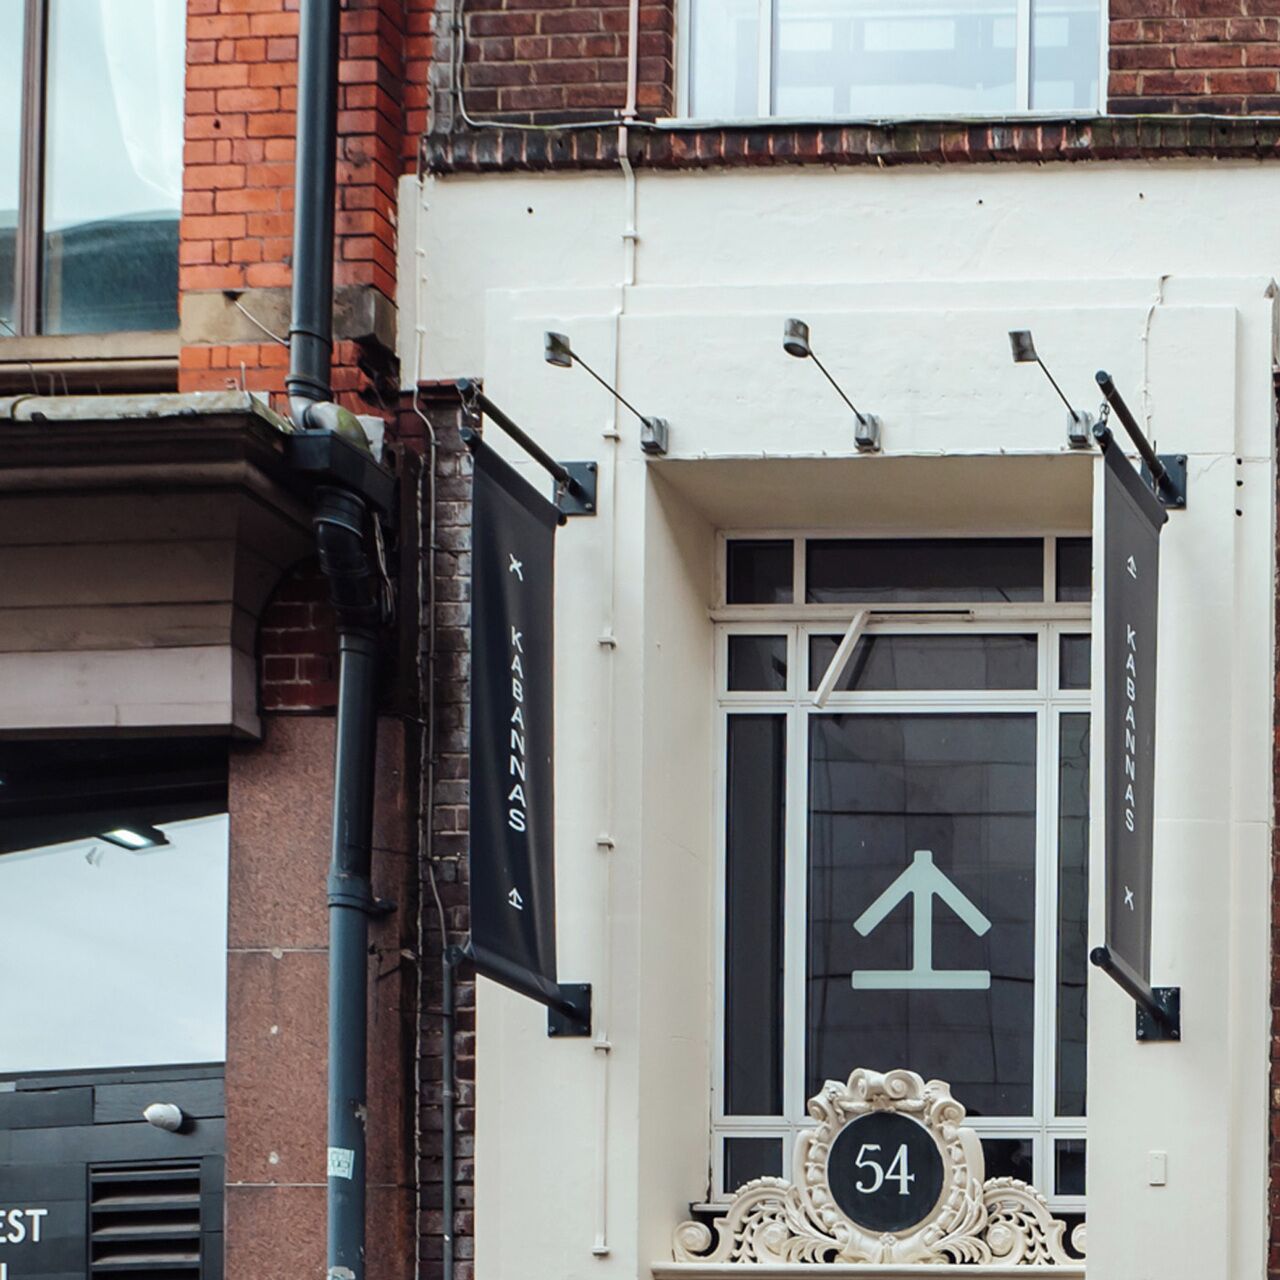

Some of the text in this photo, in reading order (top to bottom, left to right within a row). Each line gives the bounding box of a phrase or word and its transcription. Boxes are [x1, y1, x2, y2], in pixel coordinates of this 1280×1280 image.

[508, 625, 526, 833] KABANNAS
[1125, 623, 1137, 832] KABANNAS
[855, 1143, 916, 1196] 54
